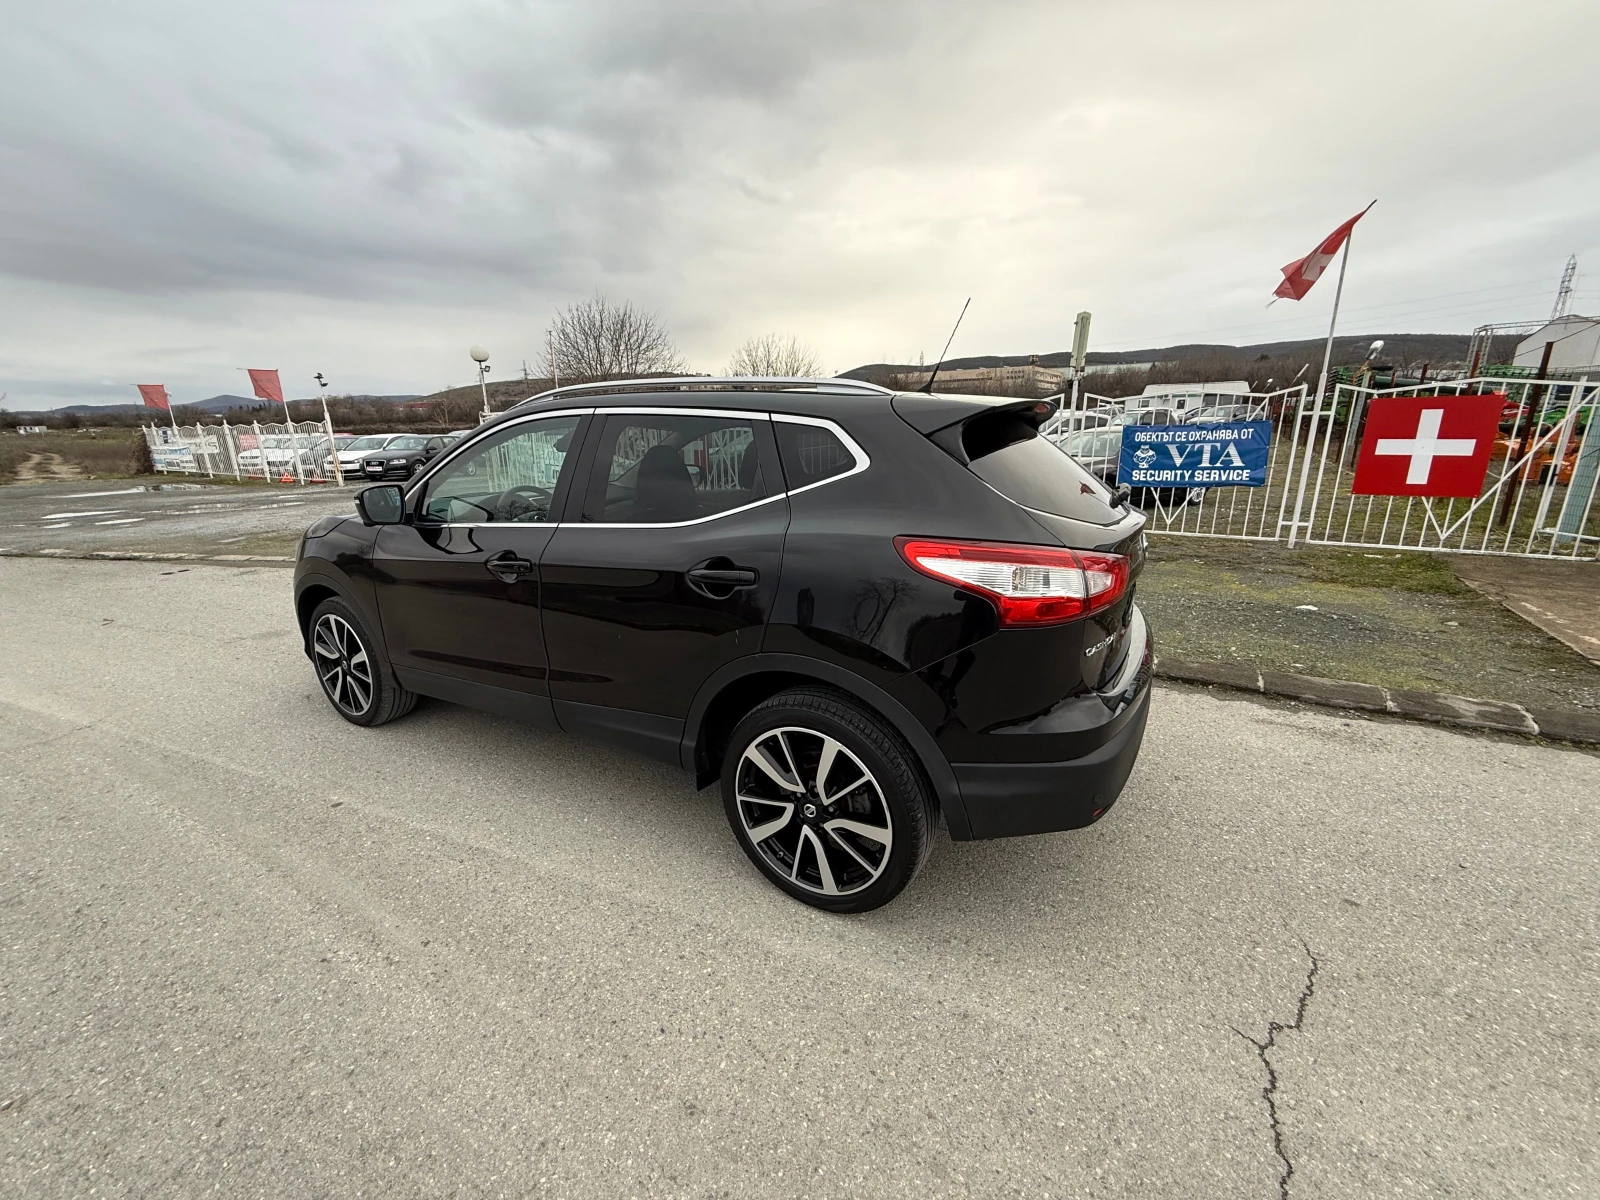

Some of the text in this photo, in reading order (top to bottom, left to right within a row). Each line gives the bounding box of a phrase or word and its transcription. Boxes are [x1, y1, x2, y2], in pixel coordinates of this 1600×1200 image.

[1135, 429, 1254, 442] ОБЕКТЪТ СЕ ОХРАНЯВА ОТ
[1165, 442, 1245, 467] VTA
[1132, 470, 1250, 481] SECURITY SERVICE
